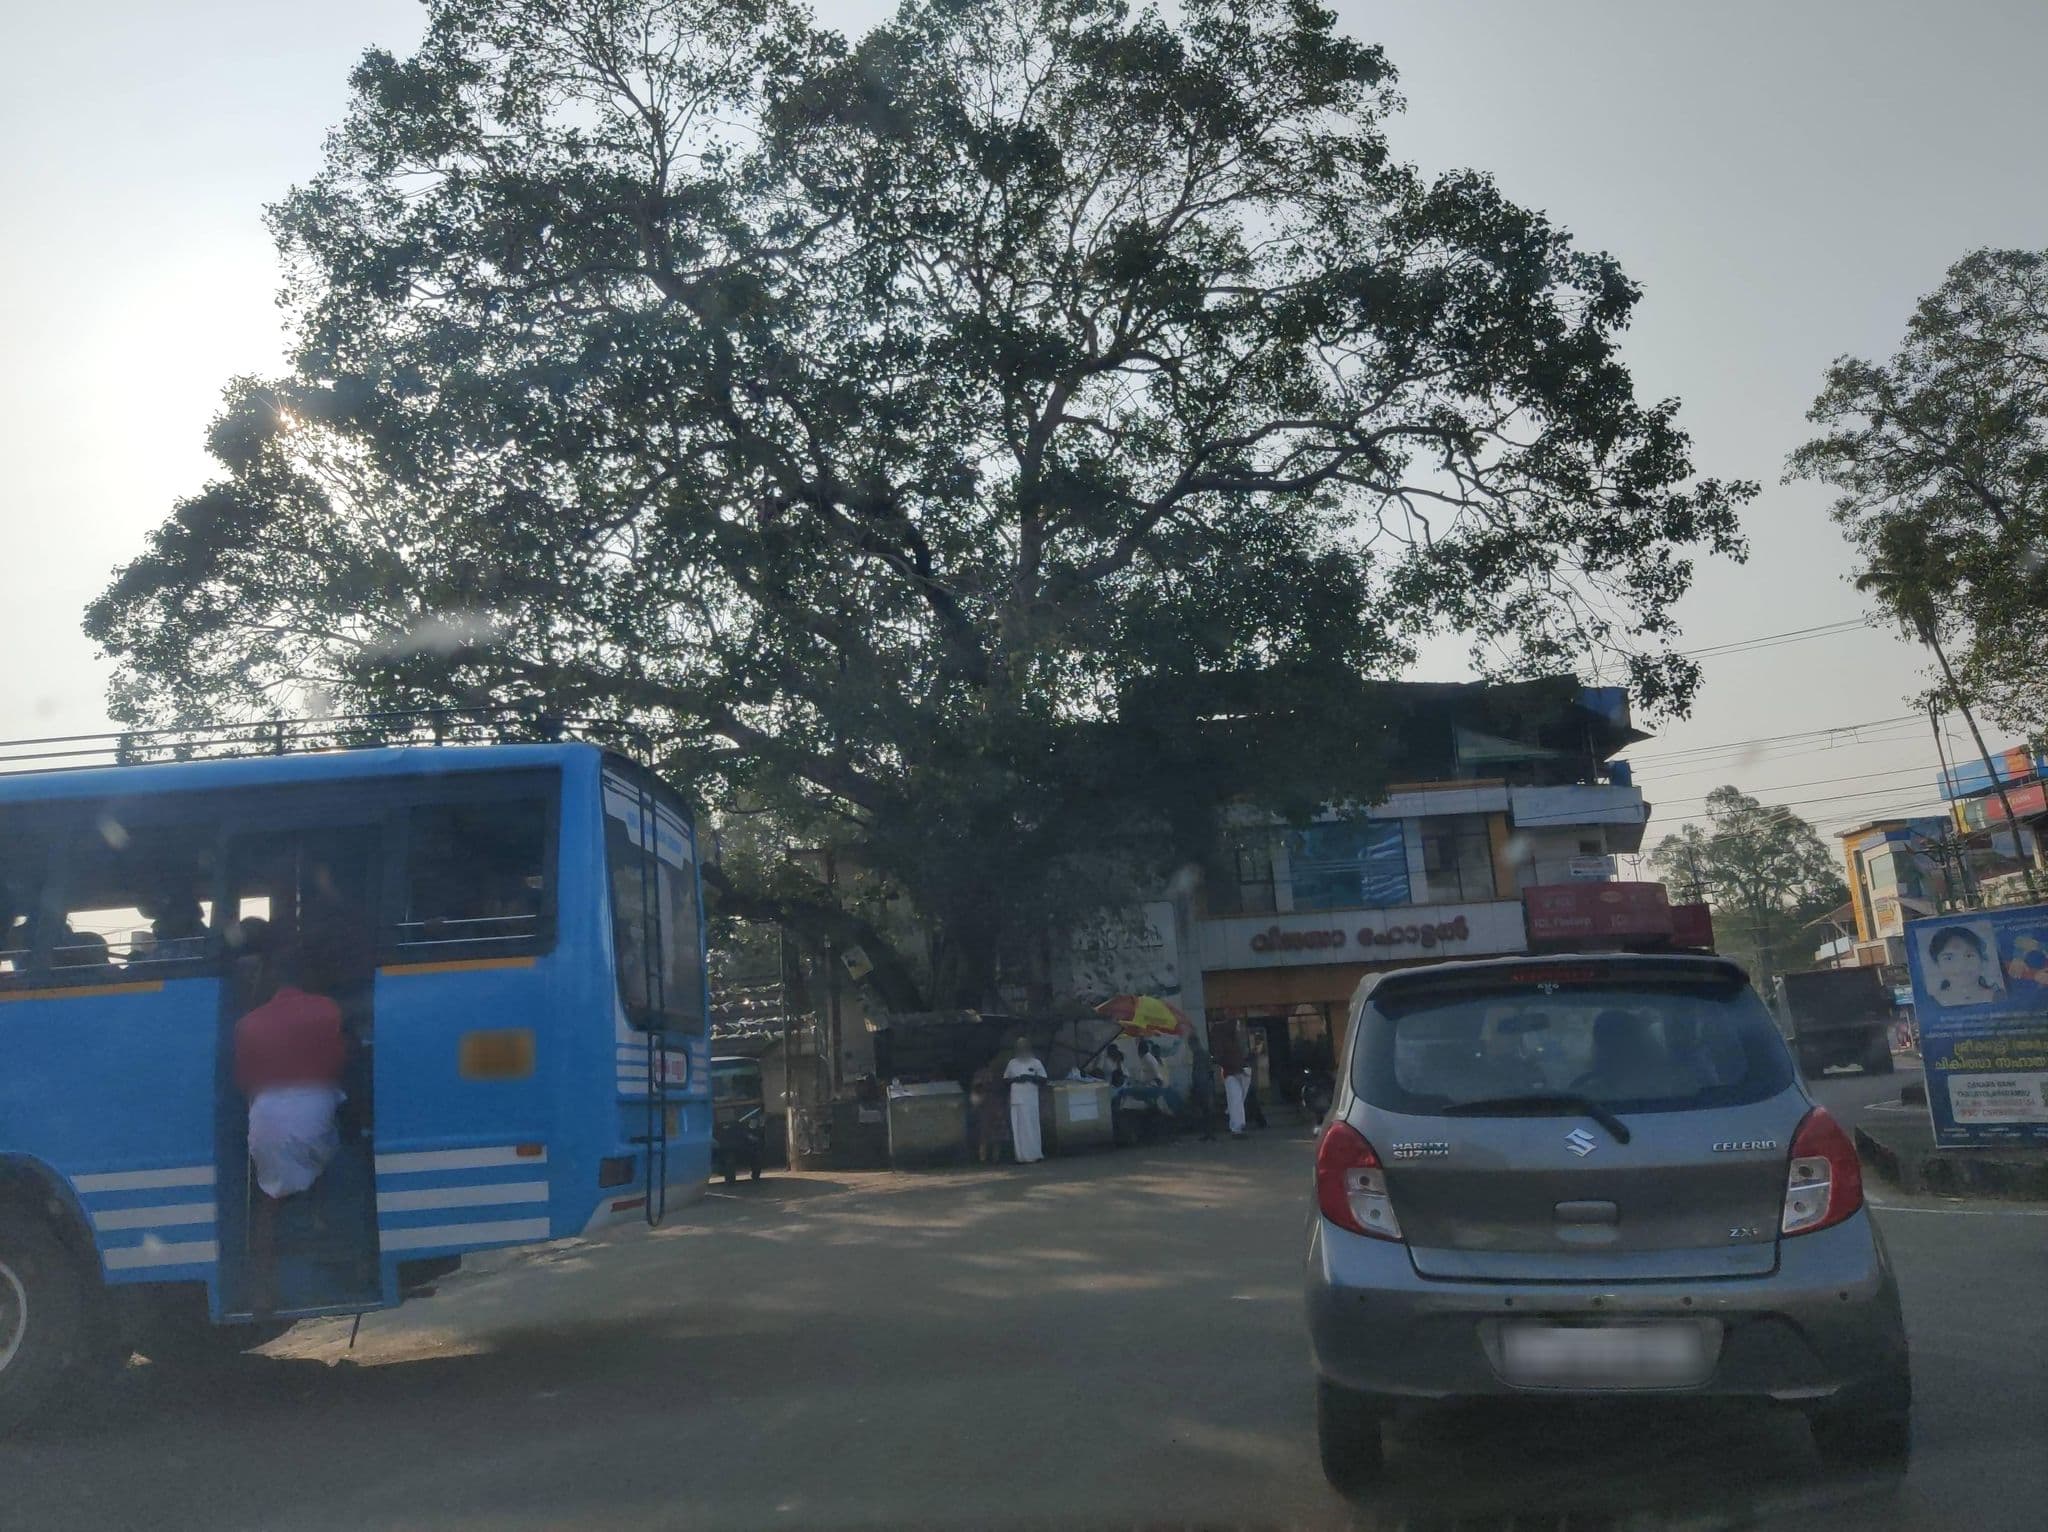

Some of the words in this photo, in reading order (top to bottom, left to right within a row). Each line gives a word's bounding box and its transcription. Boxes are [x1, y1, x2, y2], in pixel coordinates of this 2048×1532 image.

[1392, 1142, 1449, 1150] MARUTI
[1712, 1140, 1777, 1151] CELERIO
[1392, 1150, 1449, 1159] SUZUKI
